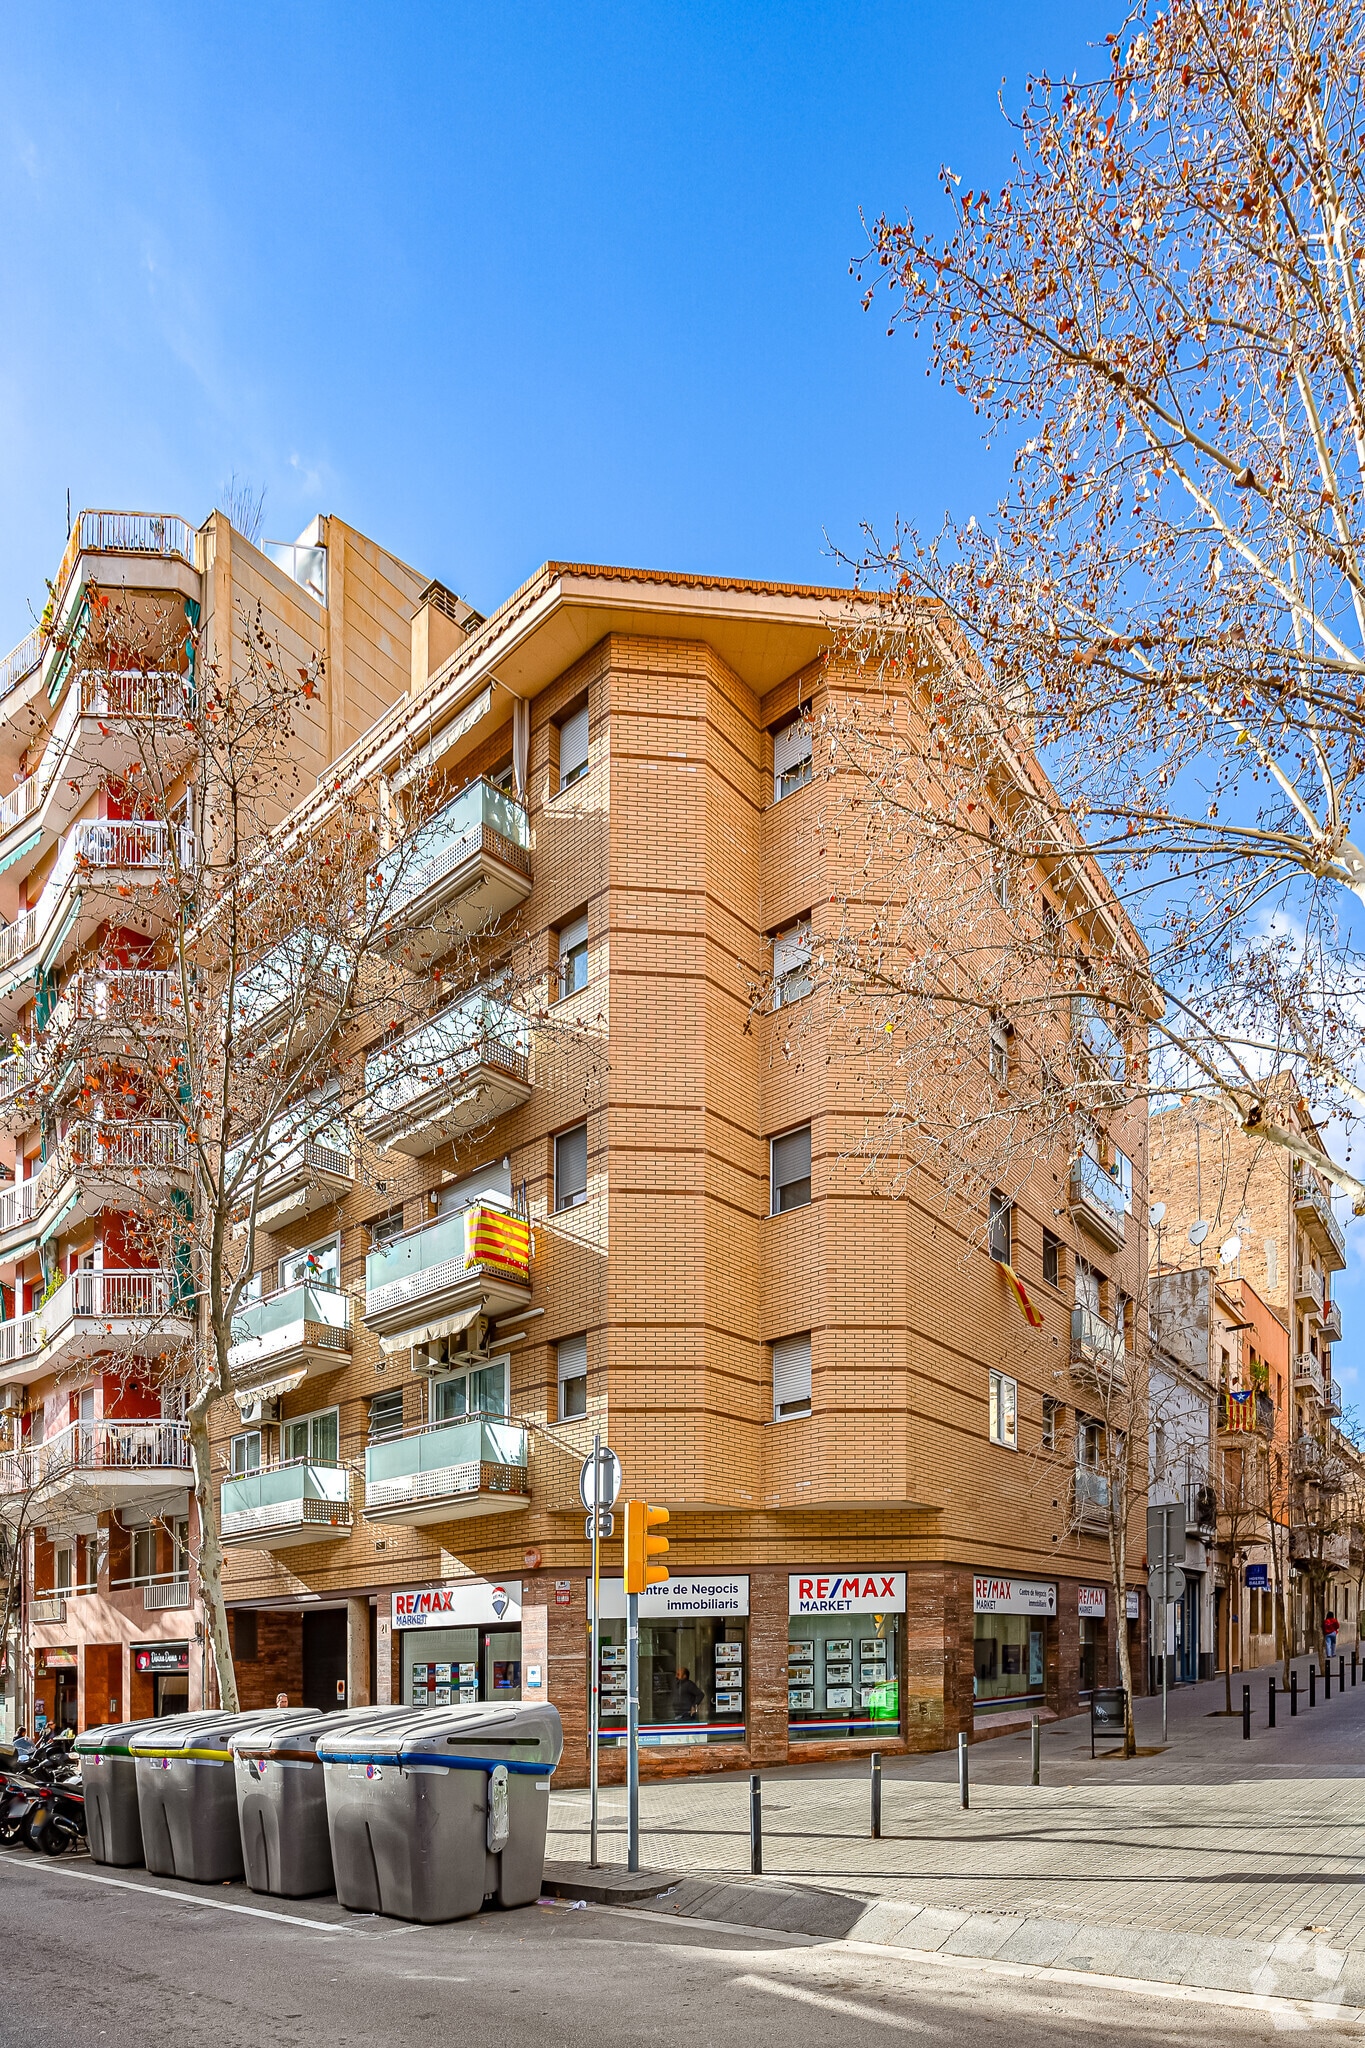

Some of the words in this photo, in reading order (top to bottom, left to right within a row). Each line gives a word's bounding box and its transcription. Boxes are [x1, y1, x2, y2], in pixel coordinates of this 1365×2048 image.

[640, 1584, 669, 1595] ntre
[673, 1584, 687, 1594] de
[691, 1583, 739, 1595] Negocis
[799, 1577, 895, 1599] RE/MAX
[975, 1579, 1011, 1599] RE/MAX
[396, 1591, 454, 1614] RE/MAX
[1079, 1588, 1103, 1605] RE/MAX
[667, 1599, 739, 1610] immobiliaris
[800, 1600, 852, 1611] MARKET
[976, 1600, 996, 1609] MARKET
[396, 1614, 427, 1625] MARKET
